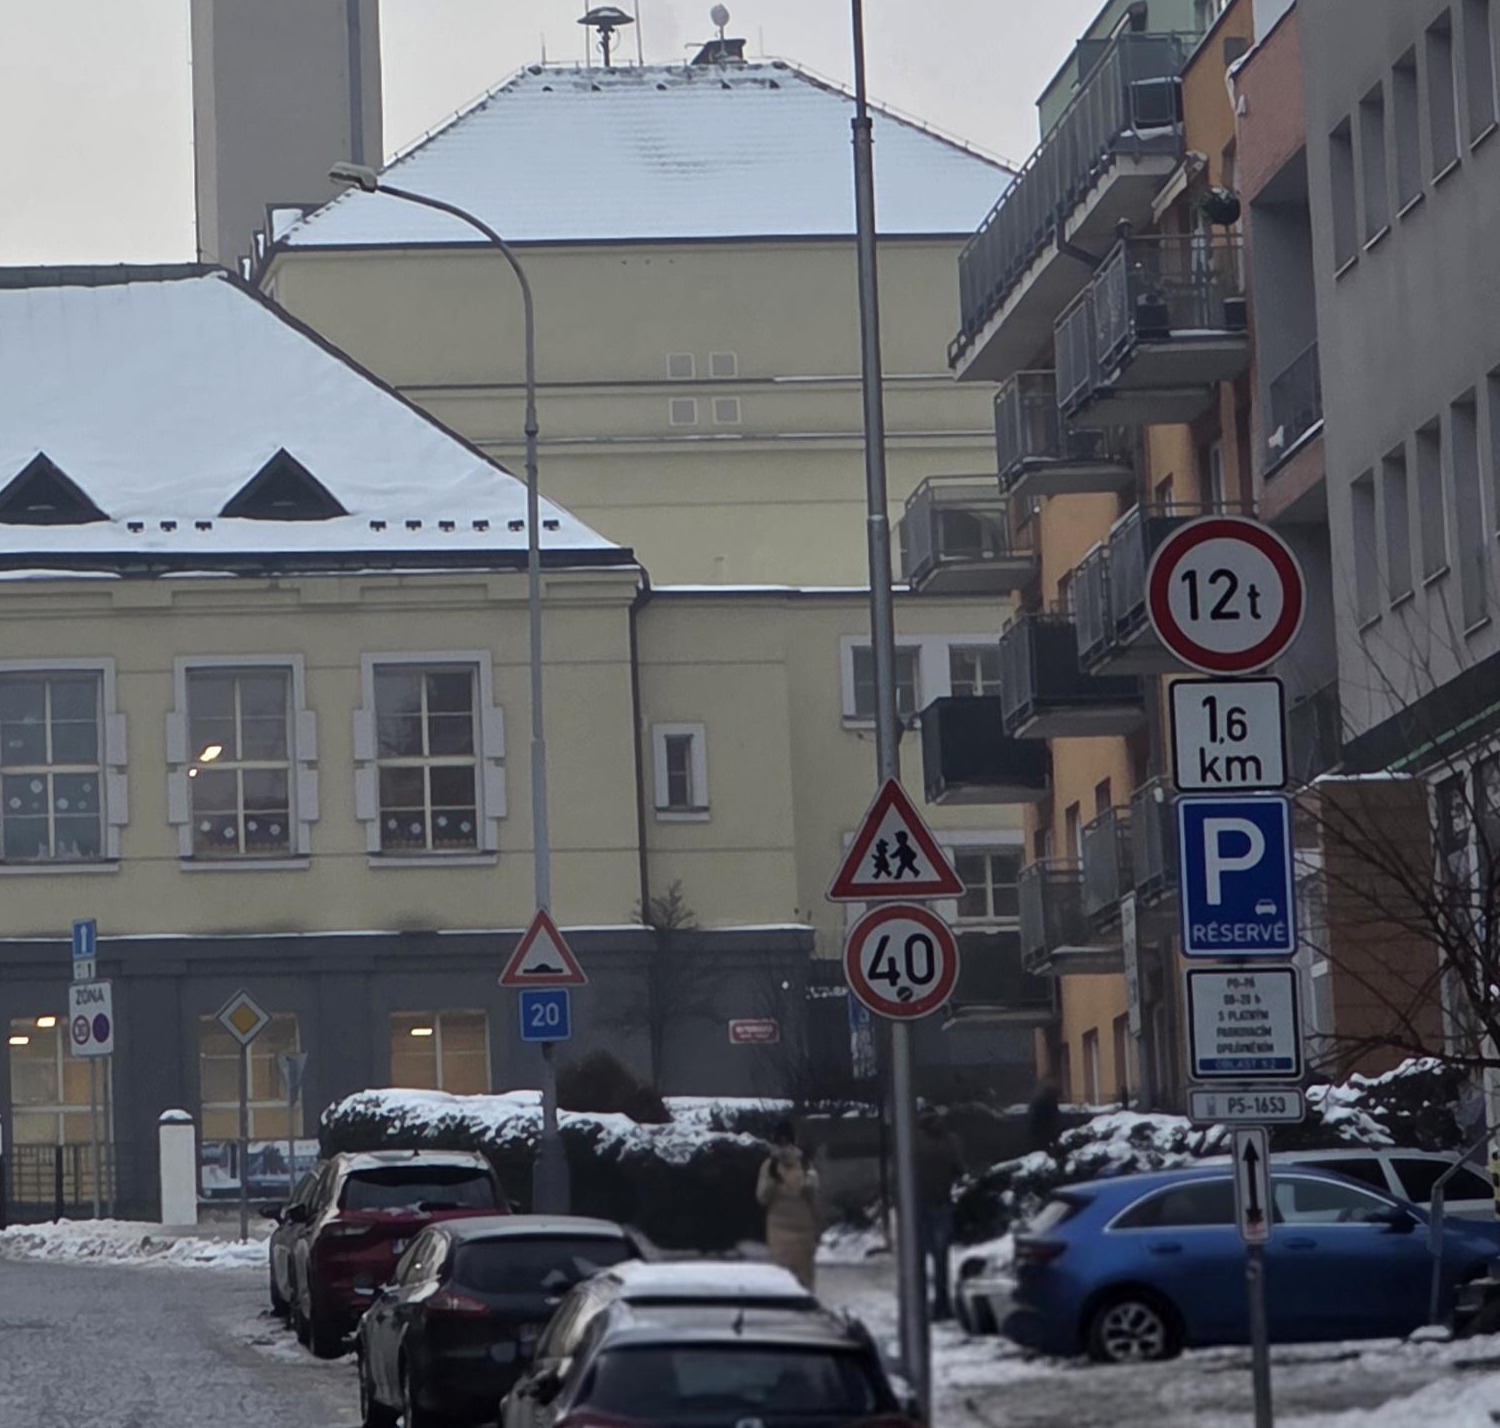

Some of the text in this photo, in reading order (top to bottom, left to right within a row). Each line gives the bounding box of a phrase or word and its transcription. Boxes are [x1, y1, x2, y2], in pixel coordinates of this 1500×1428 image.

[1202, 695, 1247, 745] 1,6
[1201, 749, 1262, 782] km
[1204, 817, 1265, 905] P
[1193, 921, 1286, 942] RÉSERVÉ
[869, 933, 935, 986] 40
[531, 1003, 559, 1026] 20
[1227, 1096, 1286, 1114] P5-1653
